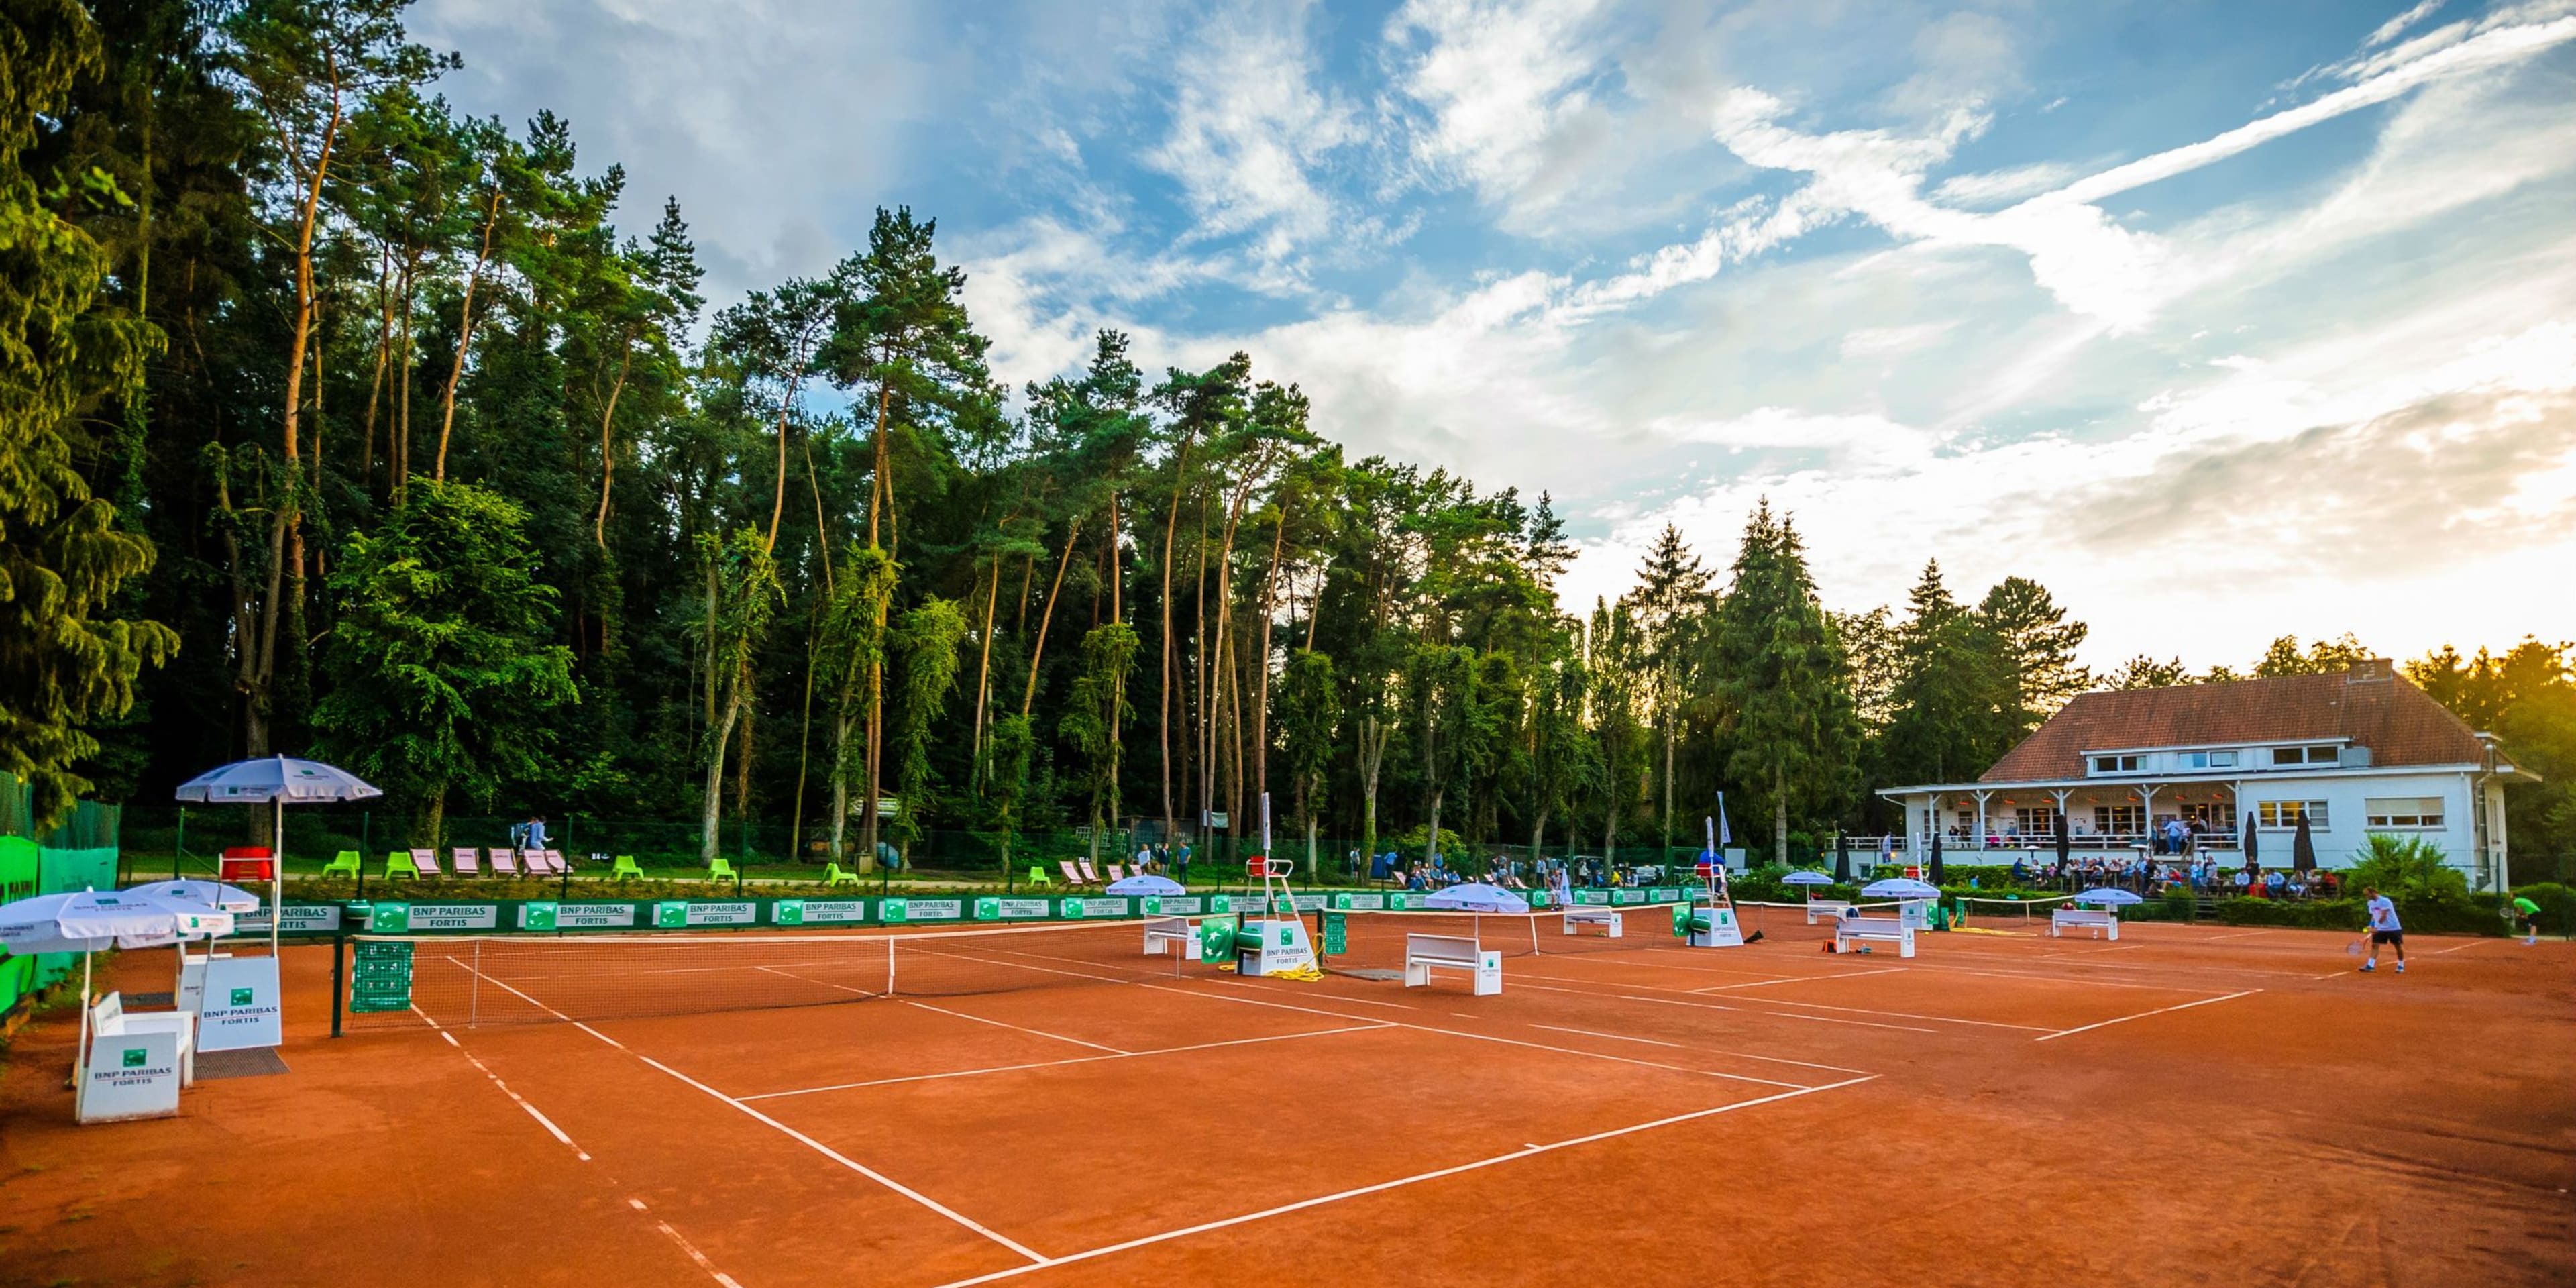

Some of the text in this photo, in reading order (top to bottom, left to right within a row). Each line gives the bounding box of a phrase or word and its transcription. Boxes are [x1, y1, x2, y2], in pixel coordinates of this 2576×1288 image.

[413, 907, 486, 916] BNP PARIBAS
[277, 921, 307, 929] RTIS
[230, 1006, 278, 1016] PARIBAS
[222, 1017, 259, 1025] FORTIS
[122, 1067, 172, 1077] PARIBAS
[113, 1078, 152, 1086] FORTIS
